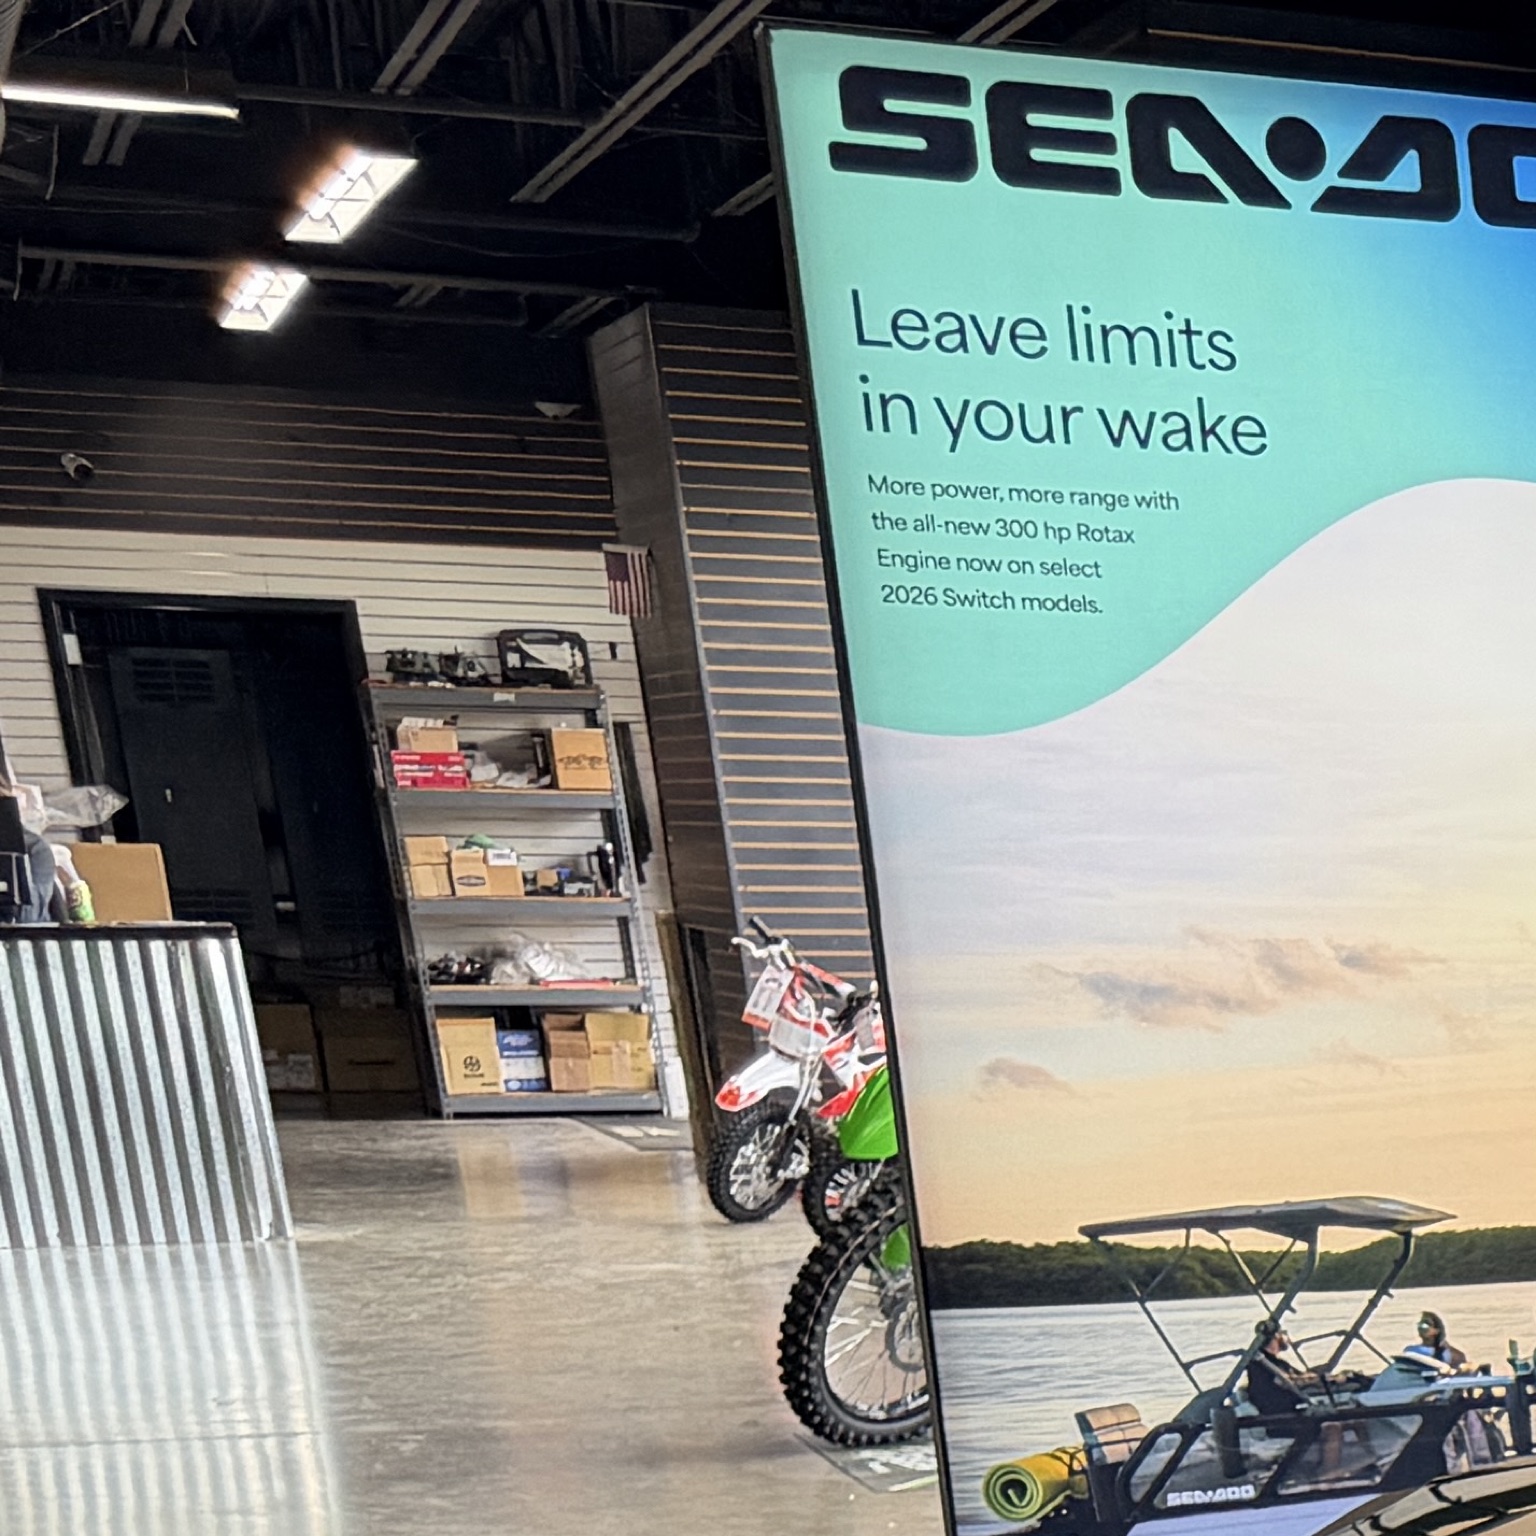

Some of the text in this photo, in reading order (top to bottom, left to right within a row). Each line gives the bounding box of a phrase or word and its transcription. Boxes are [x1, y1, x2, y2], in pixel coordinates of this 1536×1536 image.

[851, 289, 1238, 371] Leave limits
[859, 374, 1268, 456] in your wake
[867, 473, 1180, 512] More power, more range with
[871, 511, 1136, 544] the all-new 300 hp Rotax
[877, 548, 1103, 579] Engine now on select
[881, 584, 1104, 614] 2026 Switch models.
